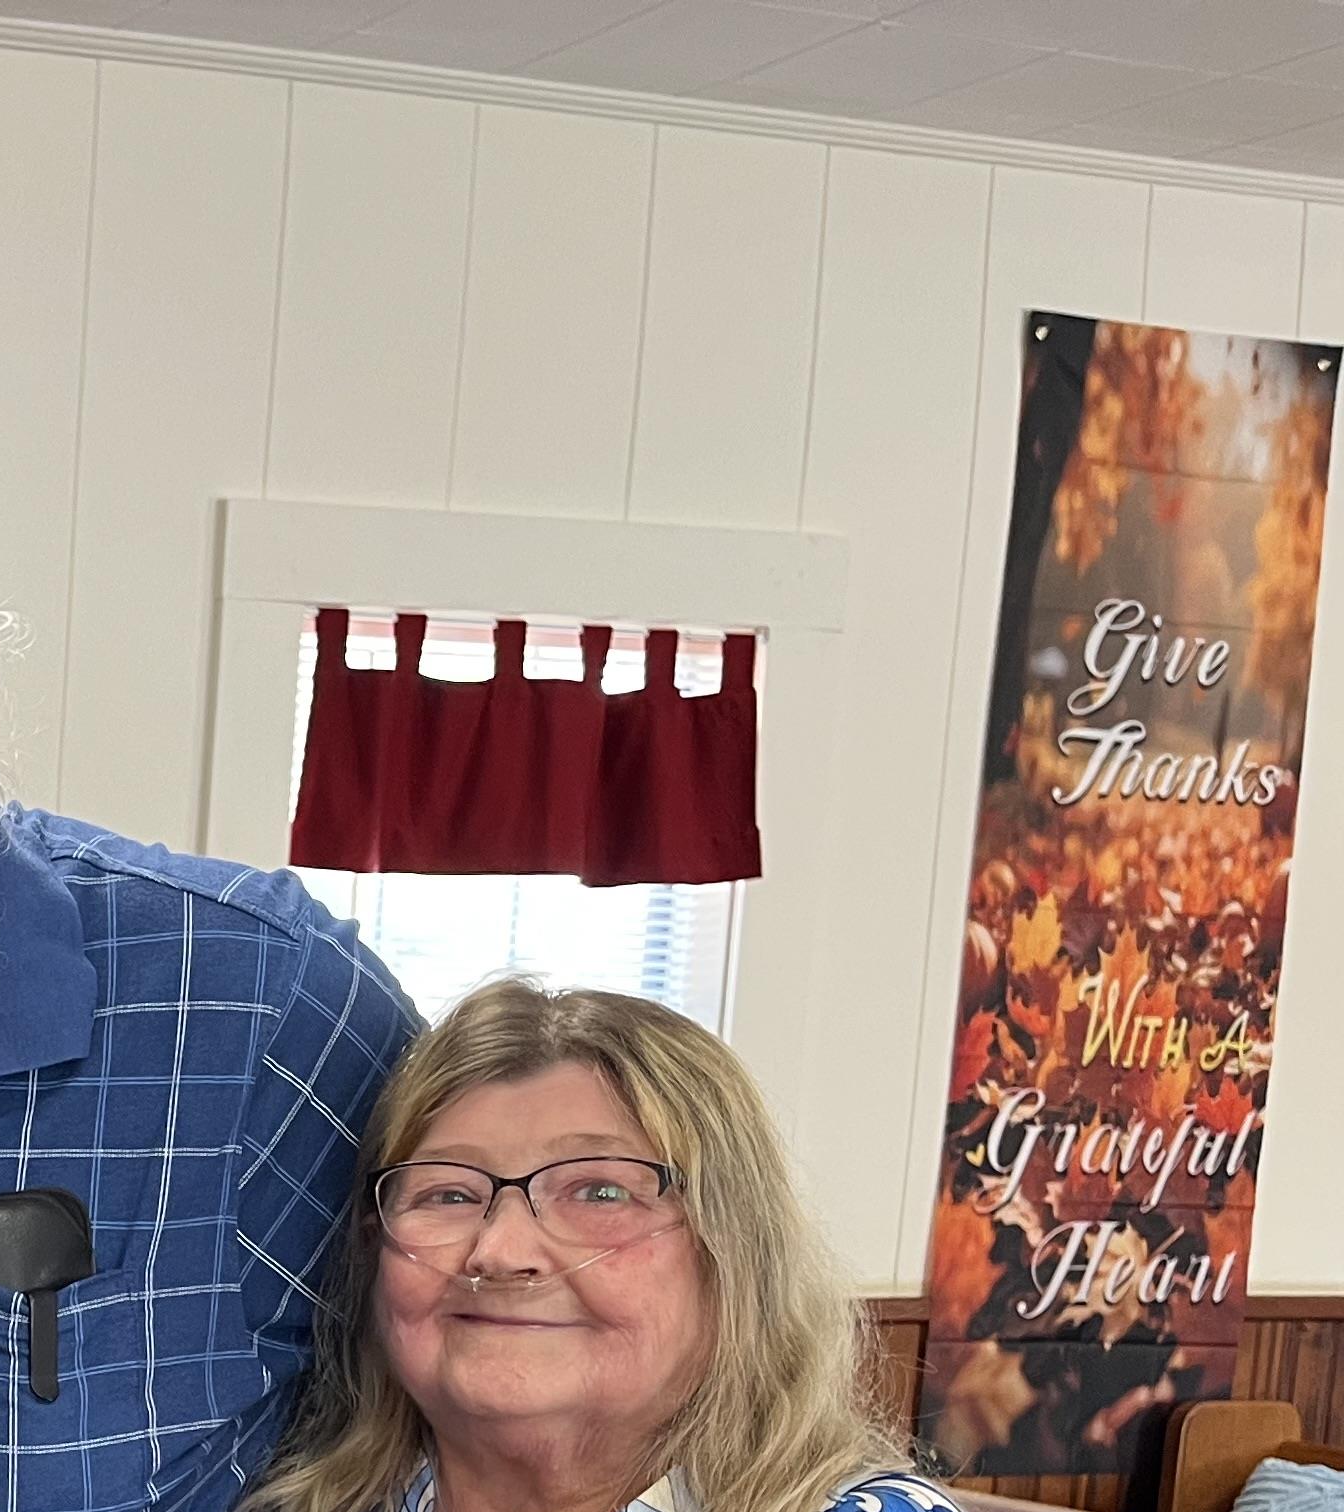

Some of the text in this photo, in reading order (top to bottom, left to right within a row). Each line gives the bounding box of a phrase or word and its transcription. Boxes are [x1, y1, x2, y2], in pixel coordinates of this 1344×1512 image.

[1067, 598, 1230, 716] Give
[1051, 719, 1279, 806] Thanks
[1200, 1010, 1254, 1073] A
[973, 1086, 1254, 1213] Grateful
[1015, 1220, 1236, 1320] Heart
